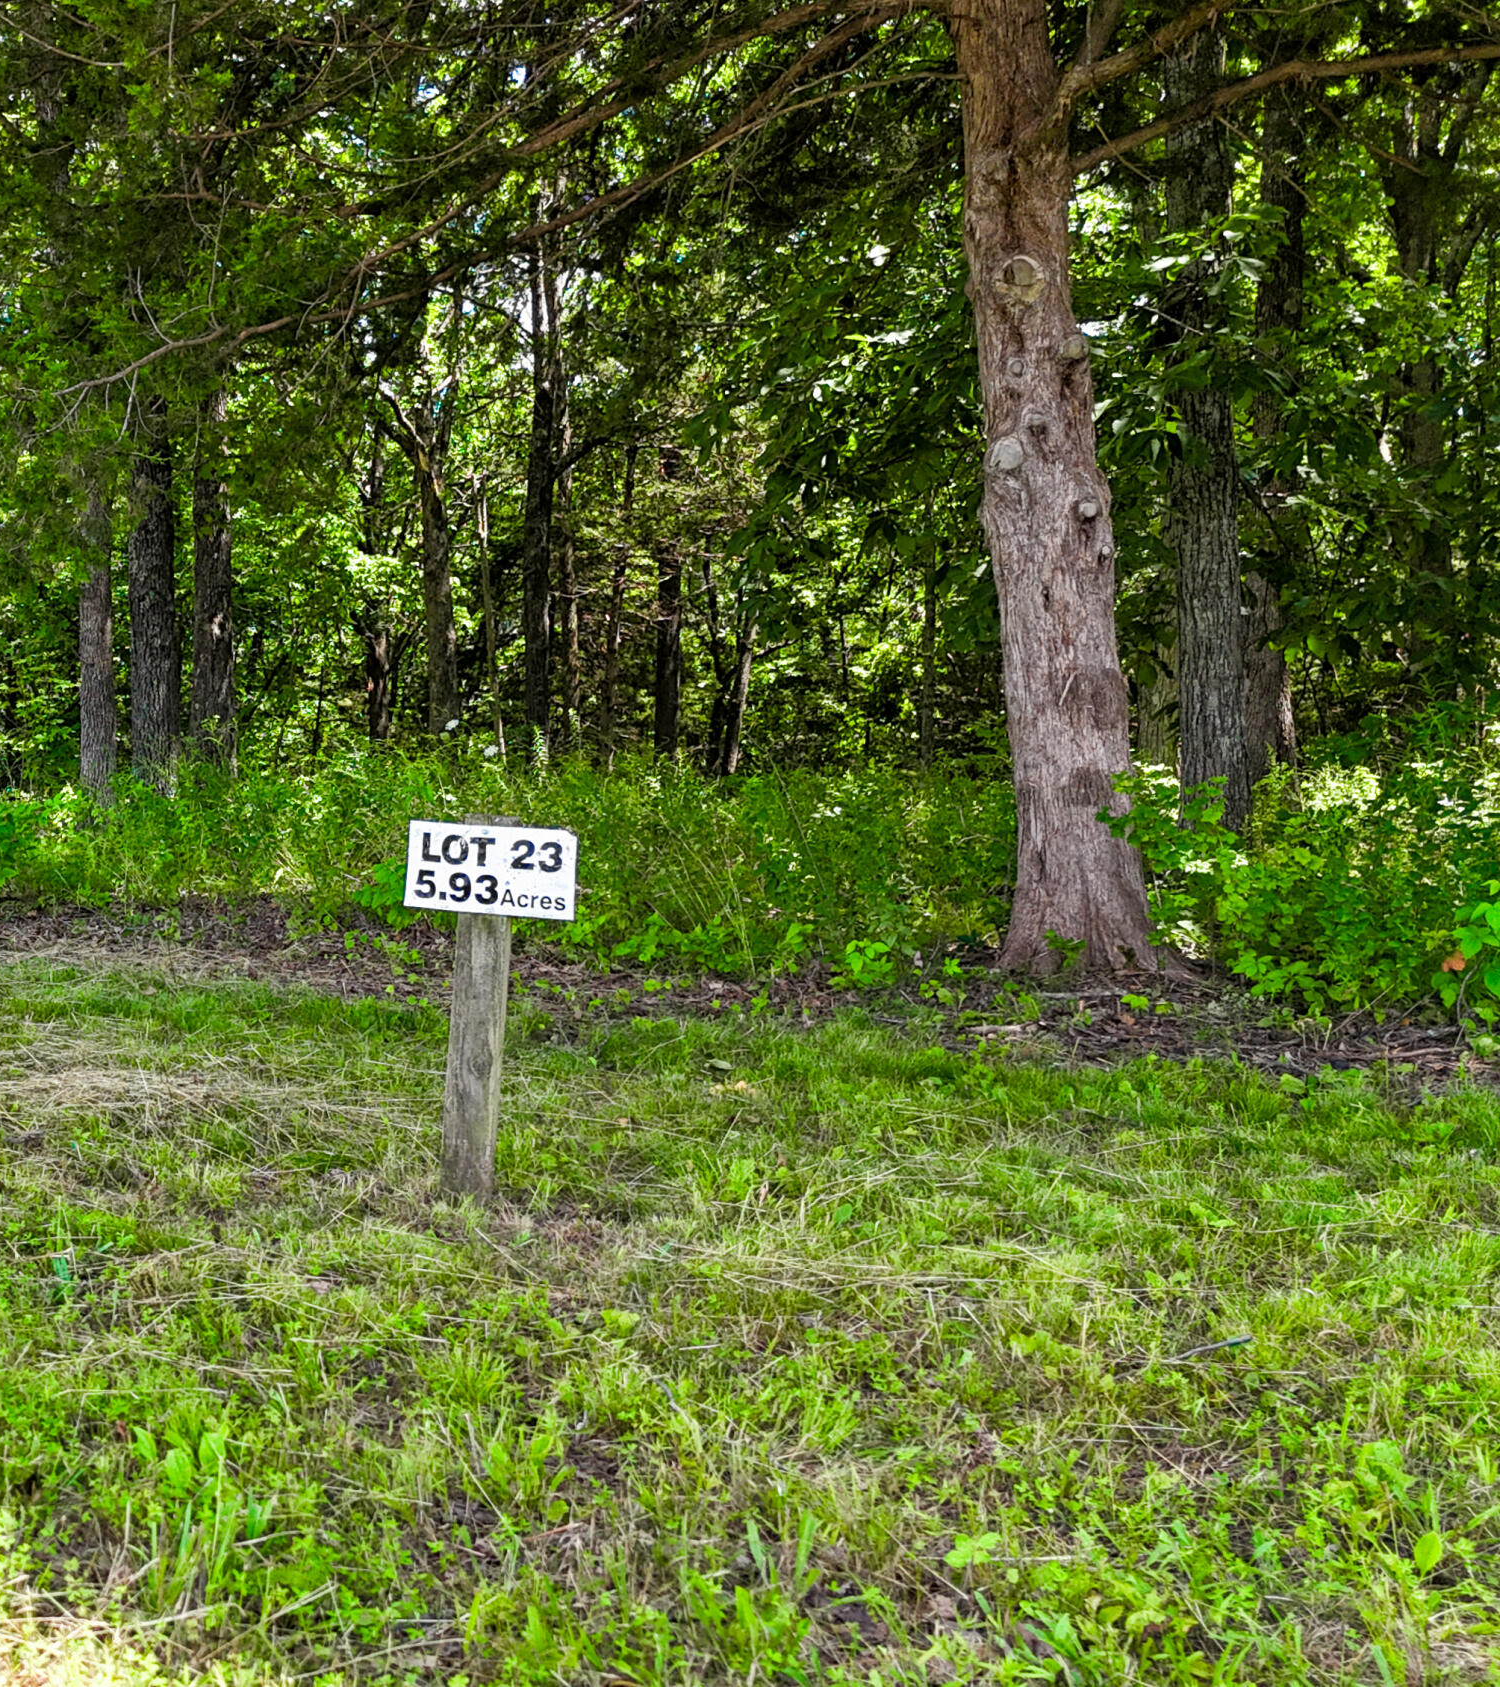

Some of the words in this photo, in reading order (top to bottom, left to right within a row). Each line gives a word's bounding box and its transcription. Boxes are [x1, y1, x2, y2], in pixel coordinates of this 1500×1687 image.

[421, 832, 496, 867] LOT
[510, 839, 563, 873] 23
[413, 869, 498, 905] 5.93
[500, 889, 566, 911] Acres
